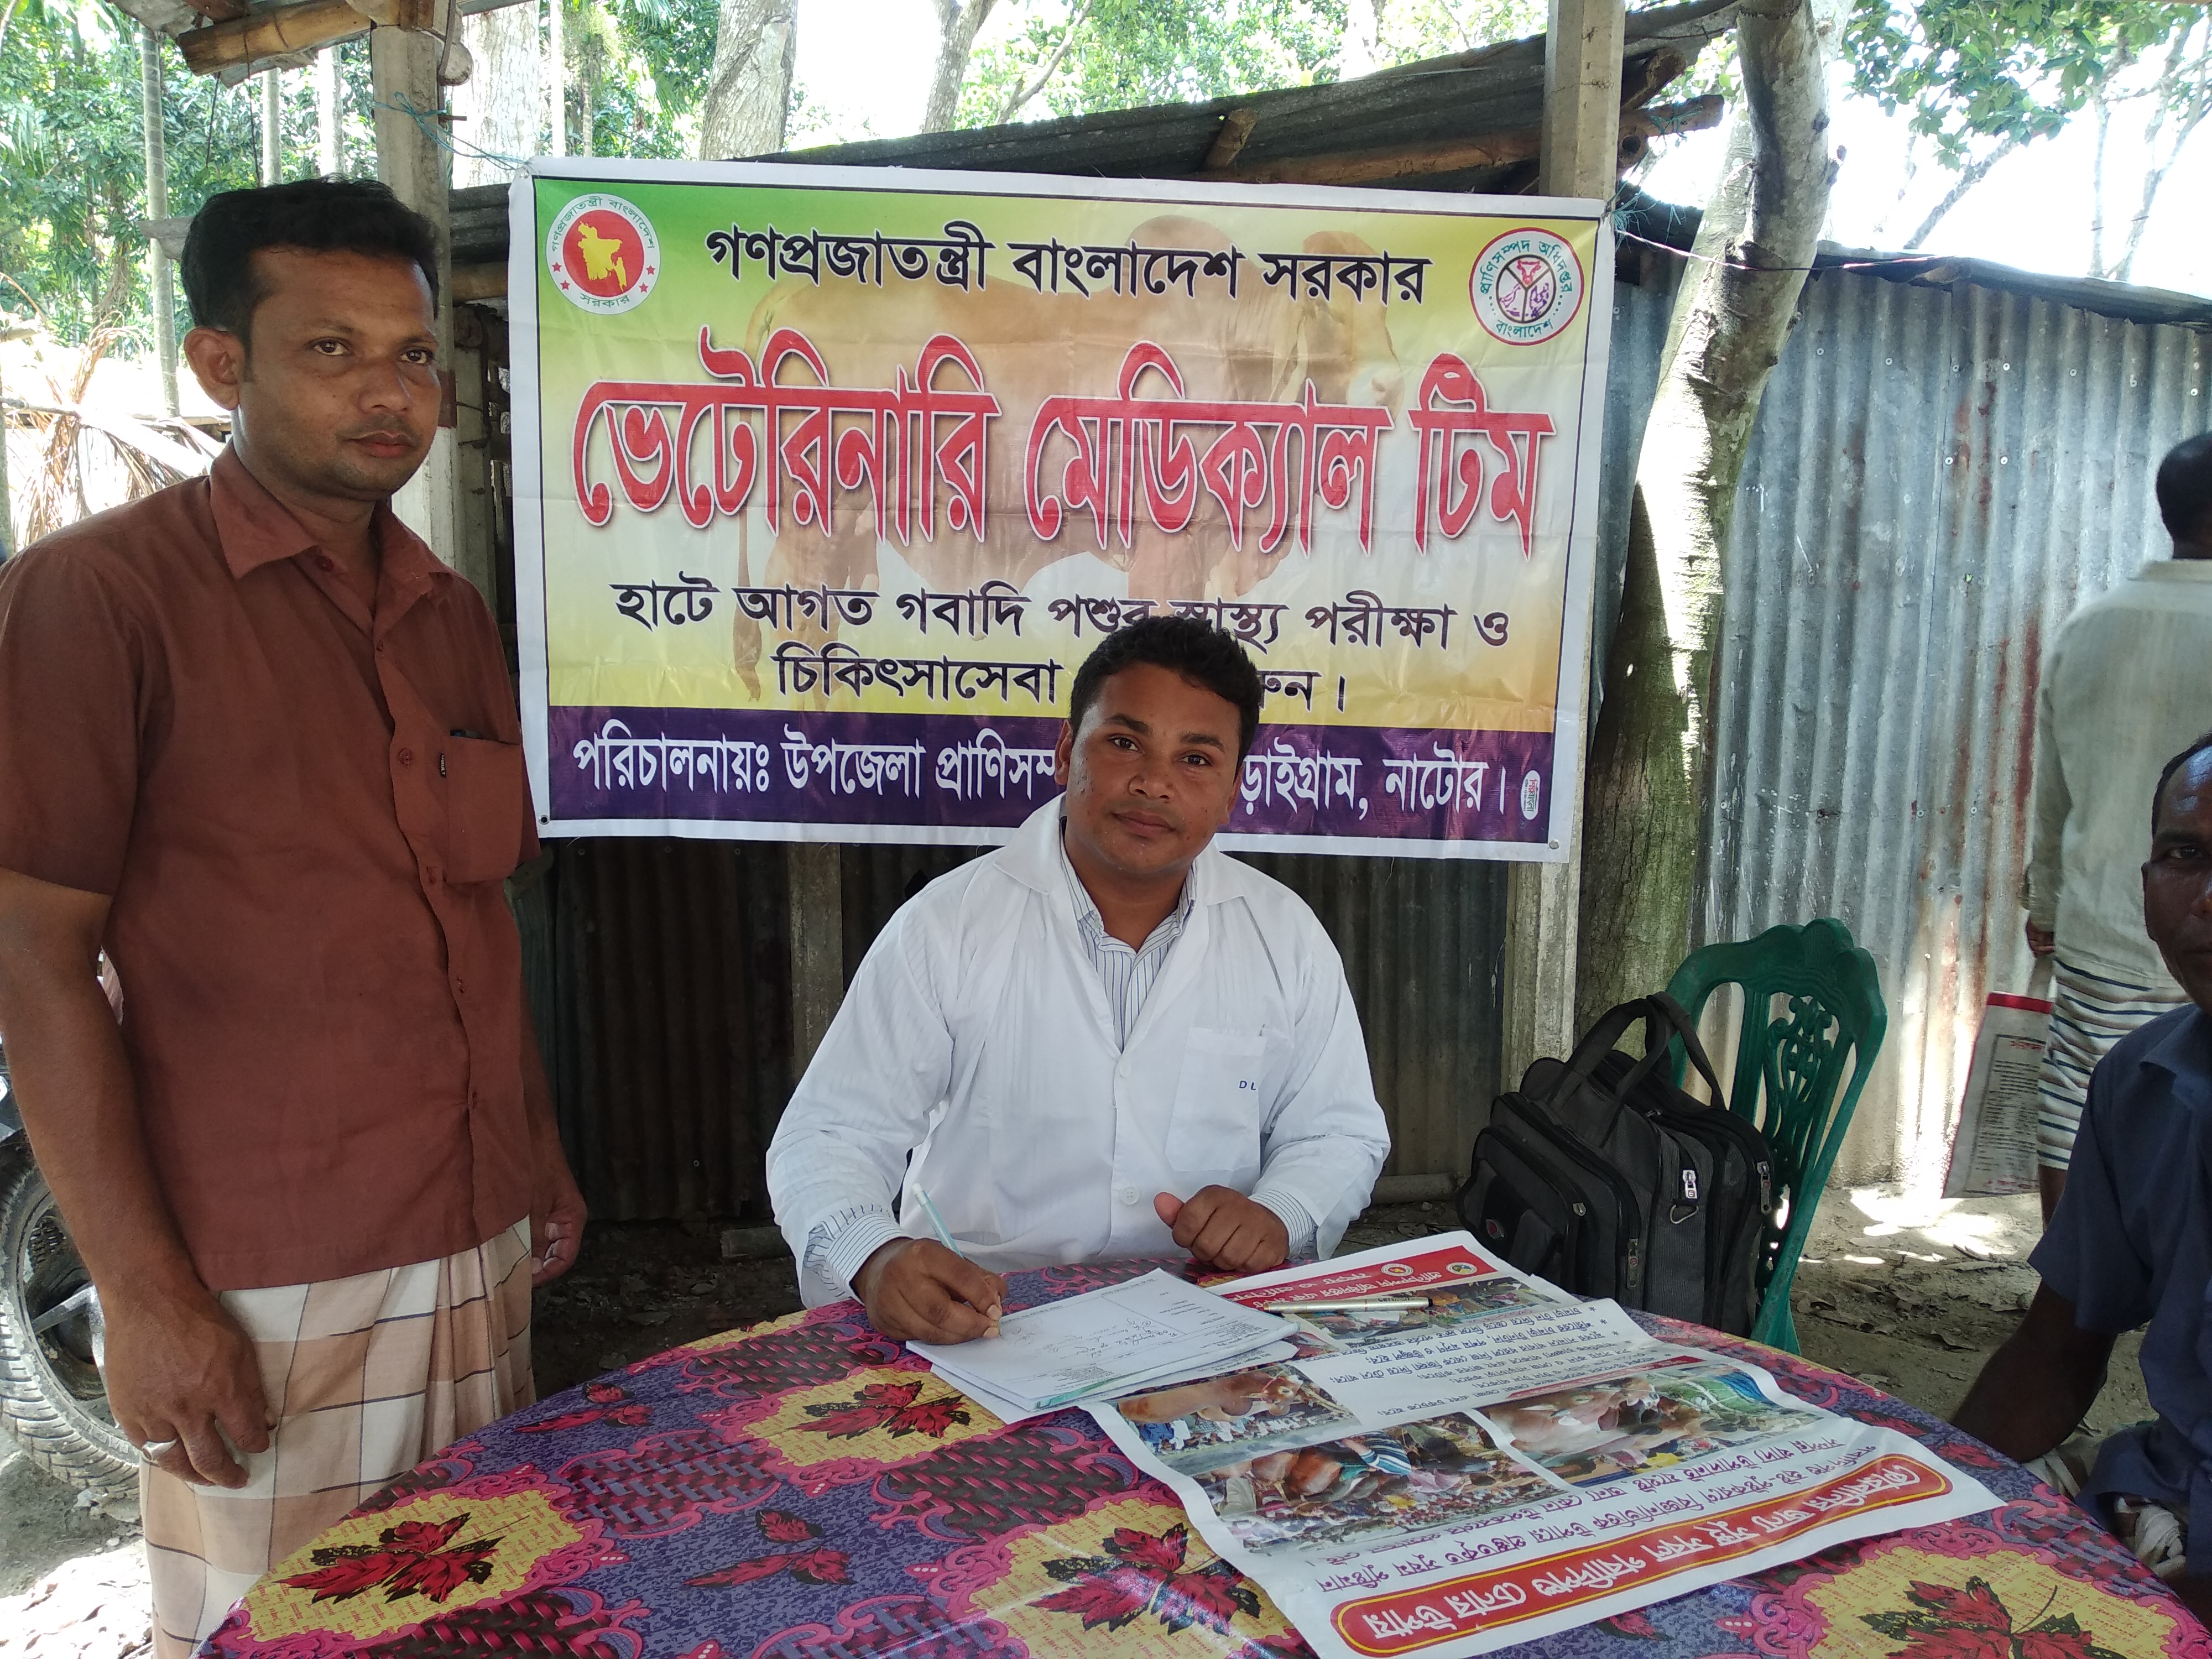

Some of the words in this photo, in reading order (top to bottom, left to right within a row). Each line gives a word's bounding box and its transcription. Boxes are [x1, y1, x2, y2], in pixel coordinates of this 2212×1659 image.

[552, 196, 602, 252] গণপ্রজাতন্ত্রী
[609, 199, 655, 249] বাংলাদেশ
[707, 220, 996, 291] গণপ্রজাতন্ত্রী
[1009, 238, 1245, 301] বাংলাদেশ
[1258, 250, 1433, 304] সরকার
[580, 293, 630, 308] সরকার
[1495, 319, 1553, 338] বাংলাদেশ
[573, 325, 1002, 547] ভেটেরিনারি
[1024, 340, 1394, 556] মেডিক্যাল
[1408, 352, 1557, 561] টিম
[609, 571, 720, 630] হাটে
[731, 582, 881, 631] আগত
[896, 580, 1032, 637] গবাদি
[1304, 589, 1458, 649] পরীক্ষা
[1473, 611, 1510, 646] ও
[770, 641, 1064, 703] চিকিৎসাসেবা
[780, 723, 925, 797] উপজেলা
[1240, 737, 1368, 821] ড়াইগ্রাম,
[1812, 1465, 1921, 1512] কোরবানির
[1707, 1521, 1760, 1547] সুস্থ
[1751, 1506, 1809, 1533] জন্য
[1641, 1536, 1714, 1563] সবল
[1532, 1554, 1646, 1596] গবাদিপশু
[1444, 1583, 1526, 1619] চেনার
[1362, 1606, 1457, 1639] উপায়
